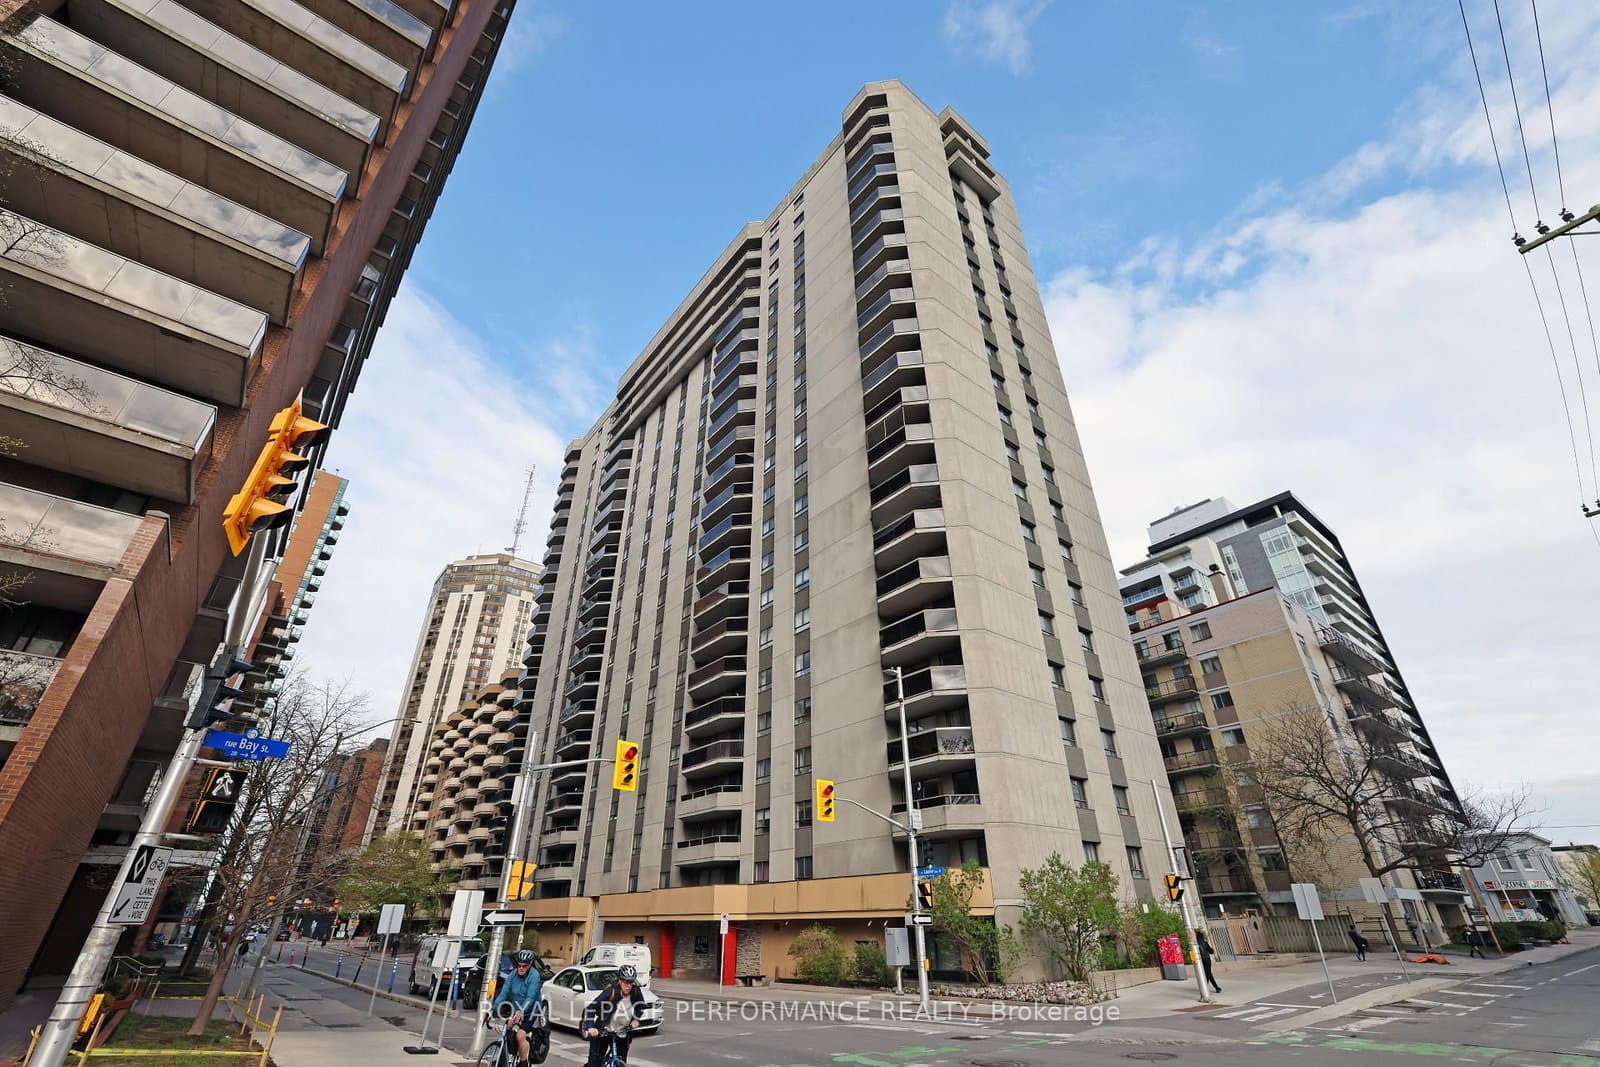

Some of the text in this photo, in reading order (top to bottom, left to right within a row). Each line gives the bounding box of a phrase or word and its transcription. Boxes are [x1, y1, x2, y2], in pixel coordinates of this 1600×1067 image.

[224, 740, 238, 748] rue
[239, 738, 259, 754] Bay
[145, 877, 157, 886] THIS
[139, 887, 155, 896] LANE
[133, 900, 150, 909] CETTE
